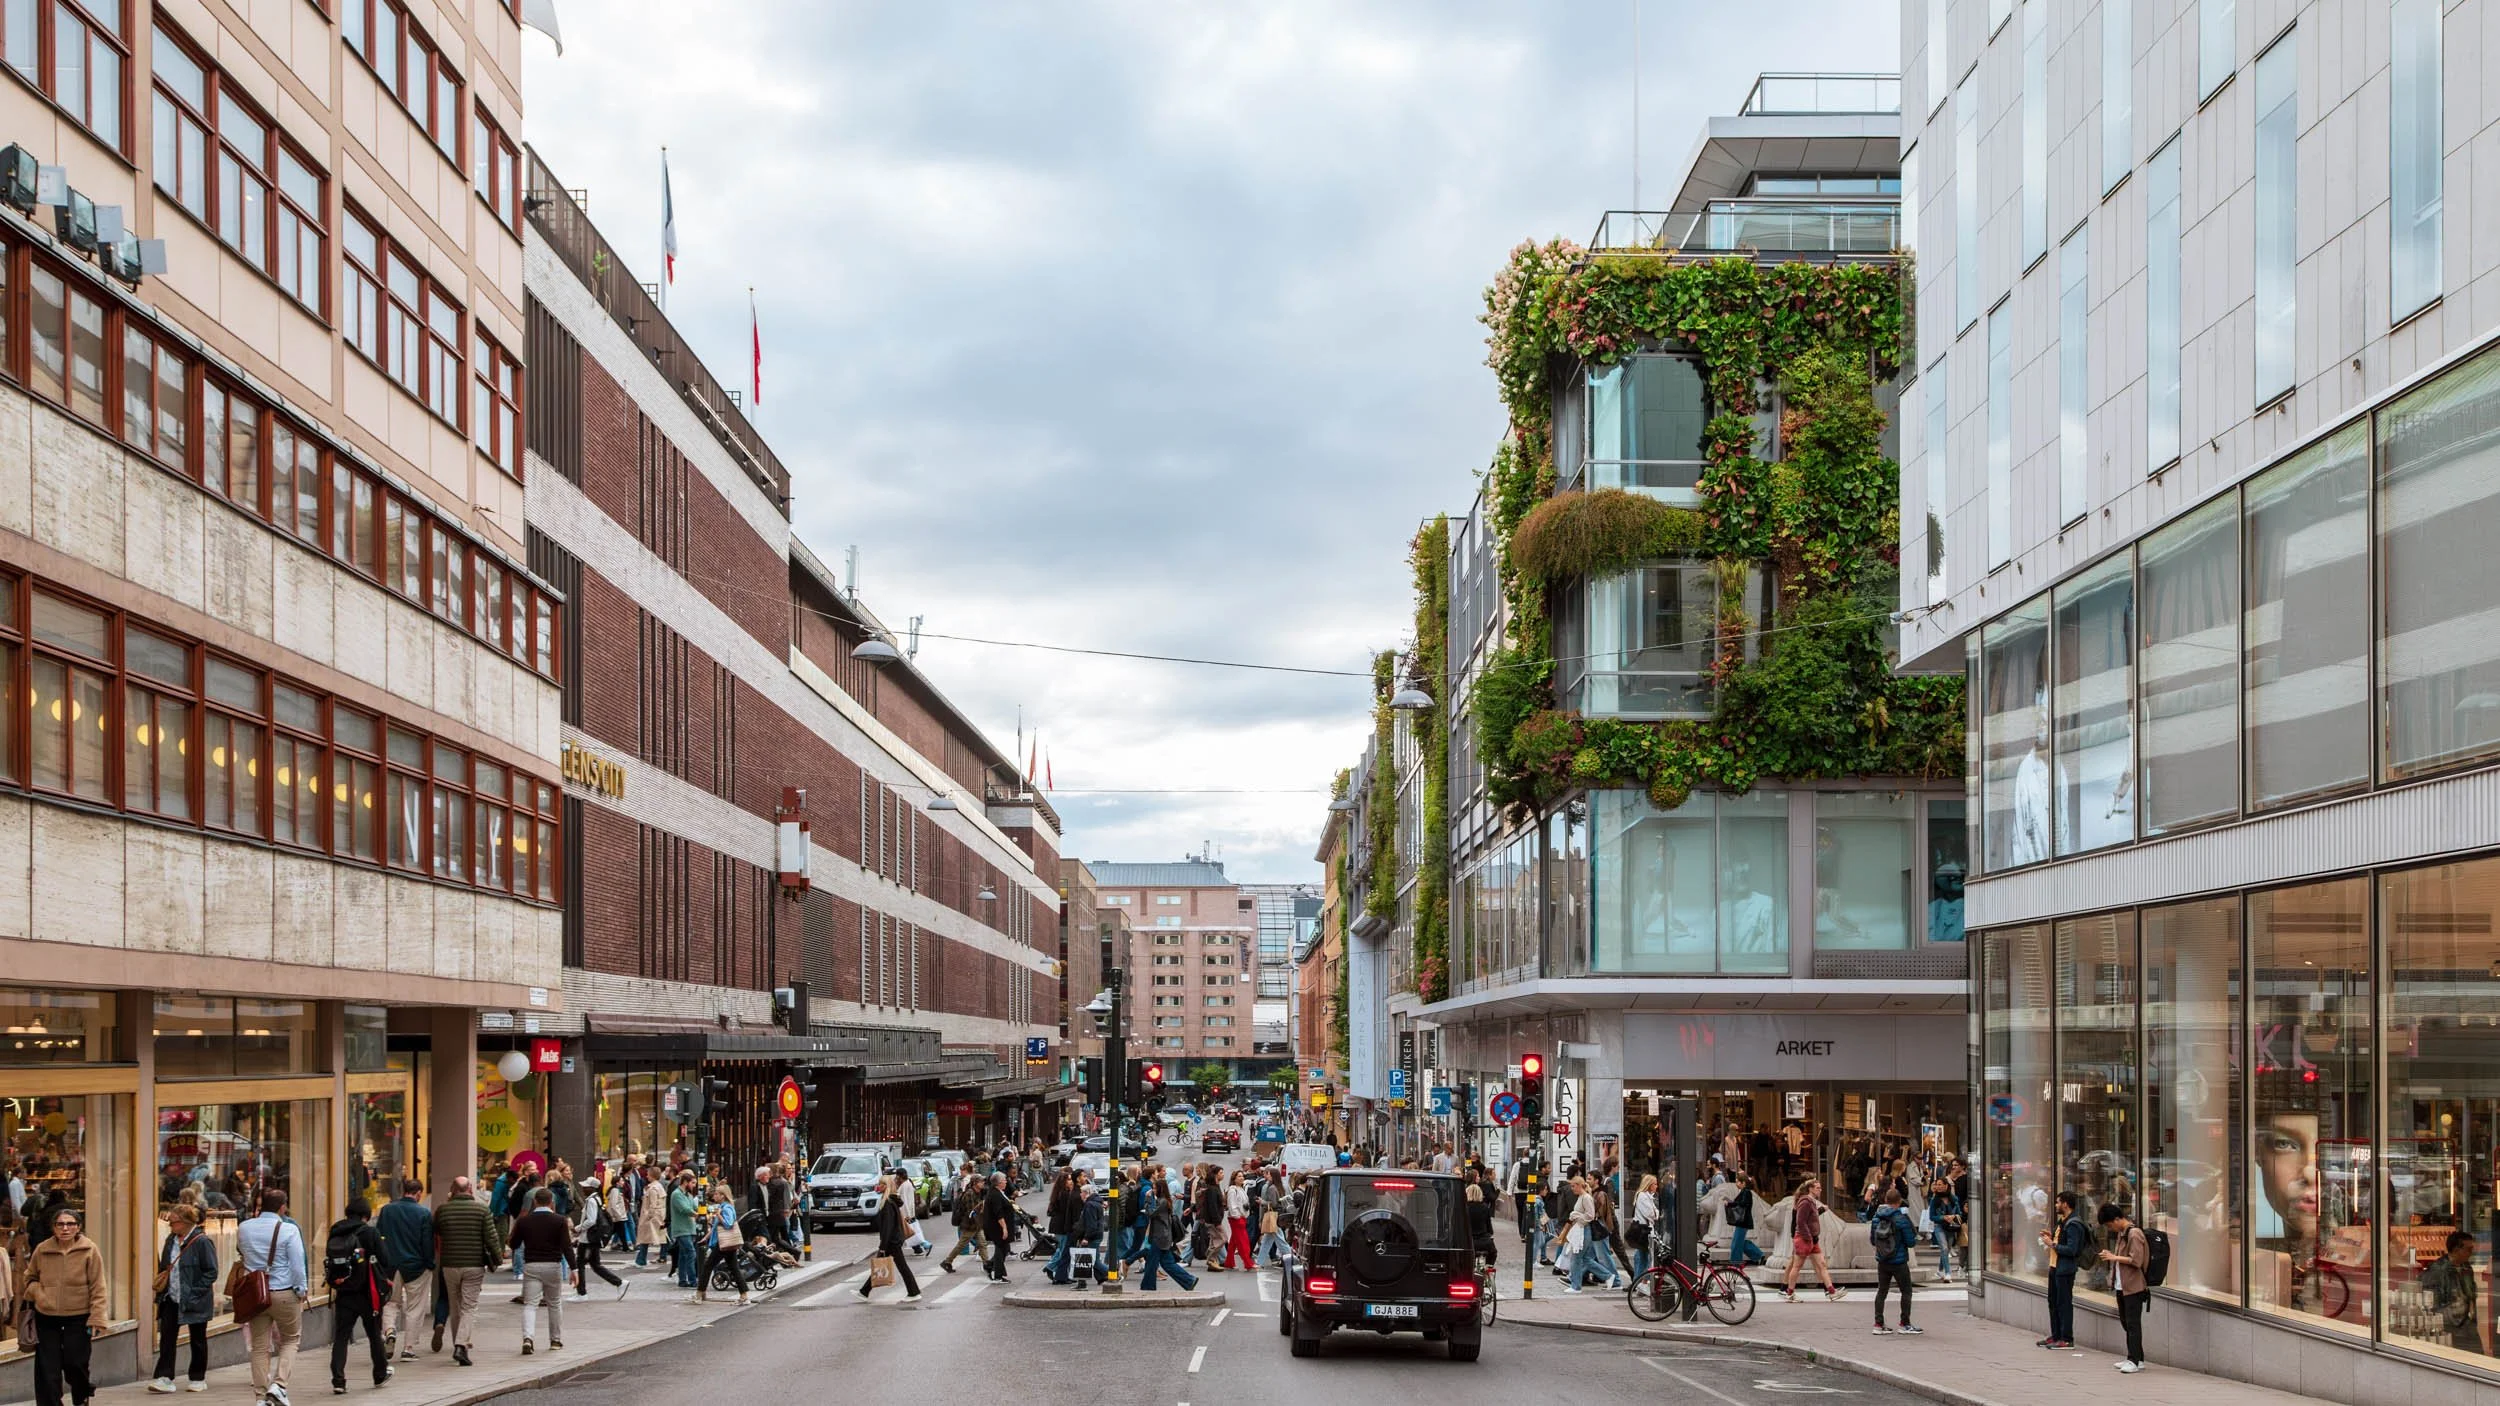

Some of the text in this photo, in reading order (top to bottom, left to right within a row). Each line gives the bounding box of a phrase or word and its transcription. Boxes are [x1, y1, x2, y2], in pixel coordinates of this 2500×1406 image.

[561, 738, 627, 800] LÉNS CITY
[1775, 1040, 1835, 1056] ARKET
[1393, 1071, 1401, 1085] P
[2063, 1083, 2081, 1103] AUTY
[1432, 1098, 1442, 1112] P
[480, 1121, 512, 1137] 30%
[1488, 1085, 1500, 1169] AKET
[1558, 1082, 1573, 1173] ARKE
[1374, 1306, 1414, 1316] GJA 88E
